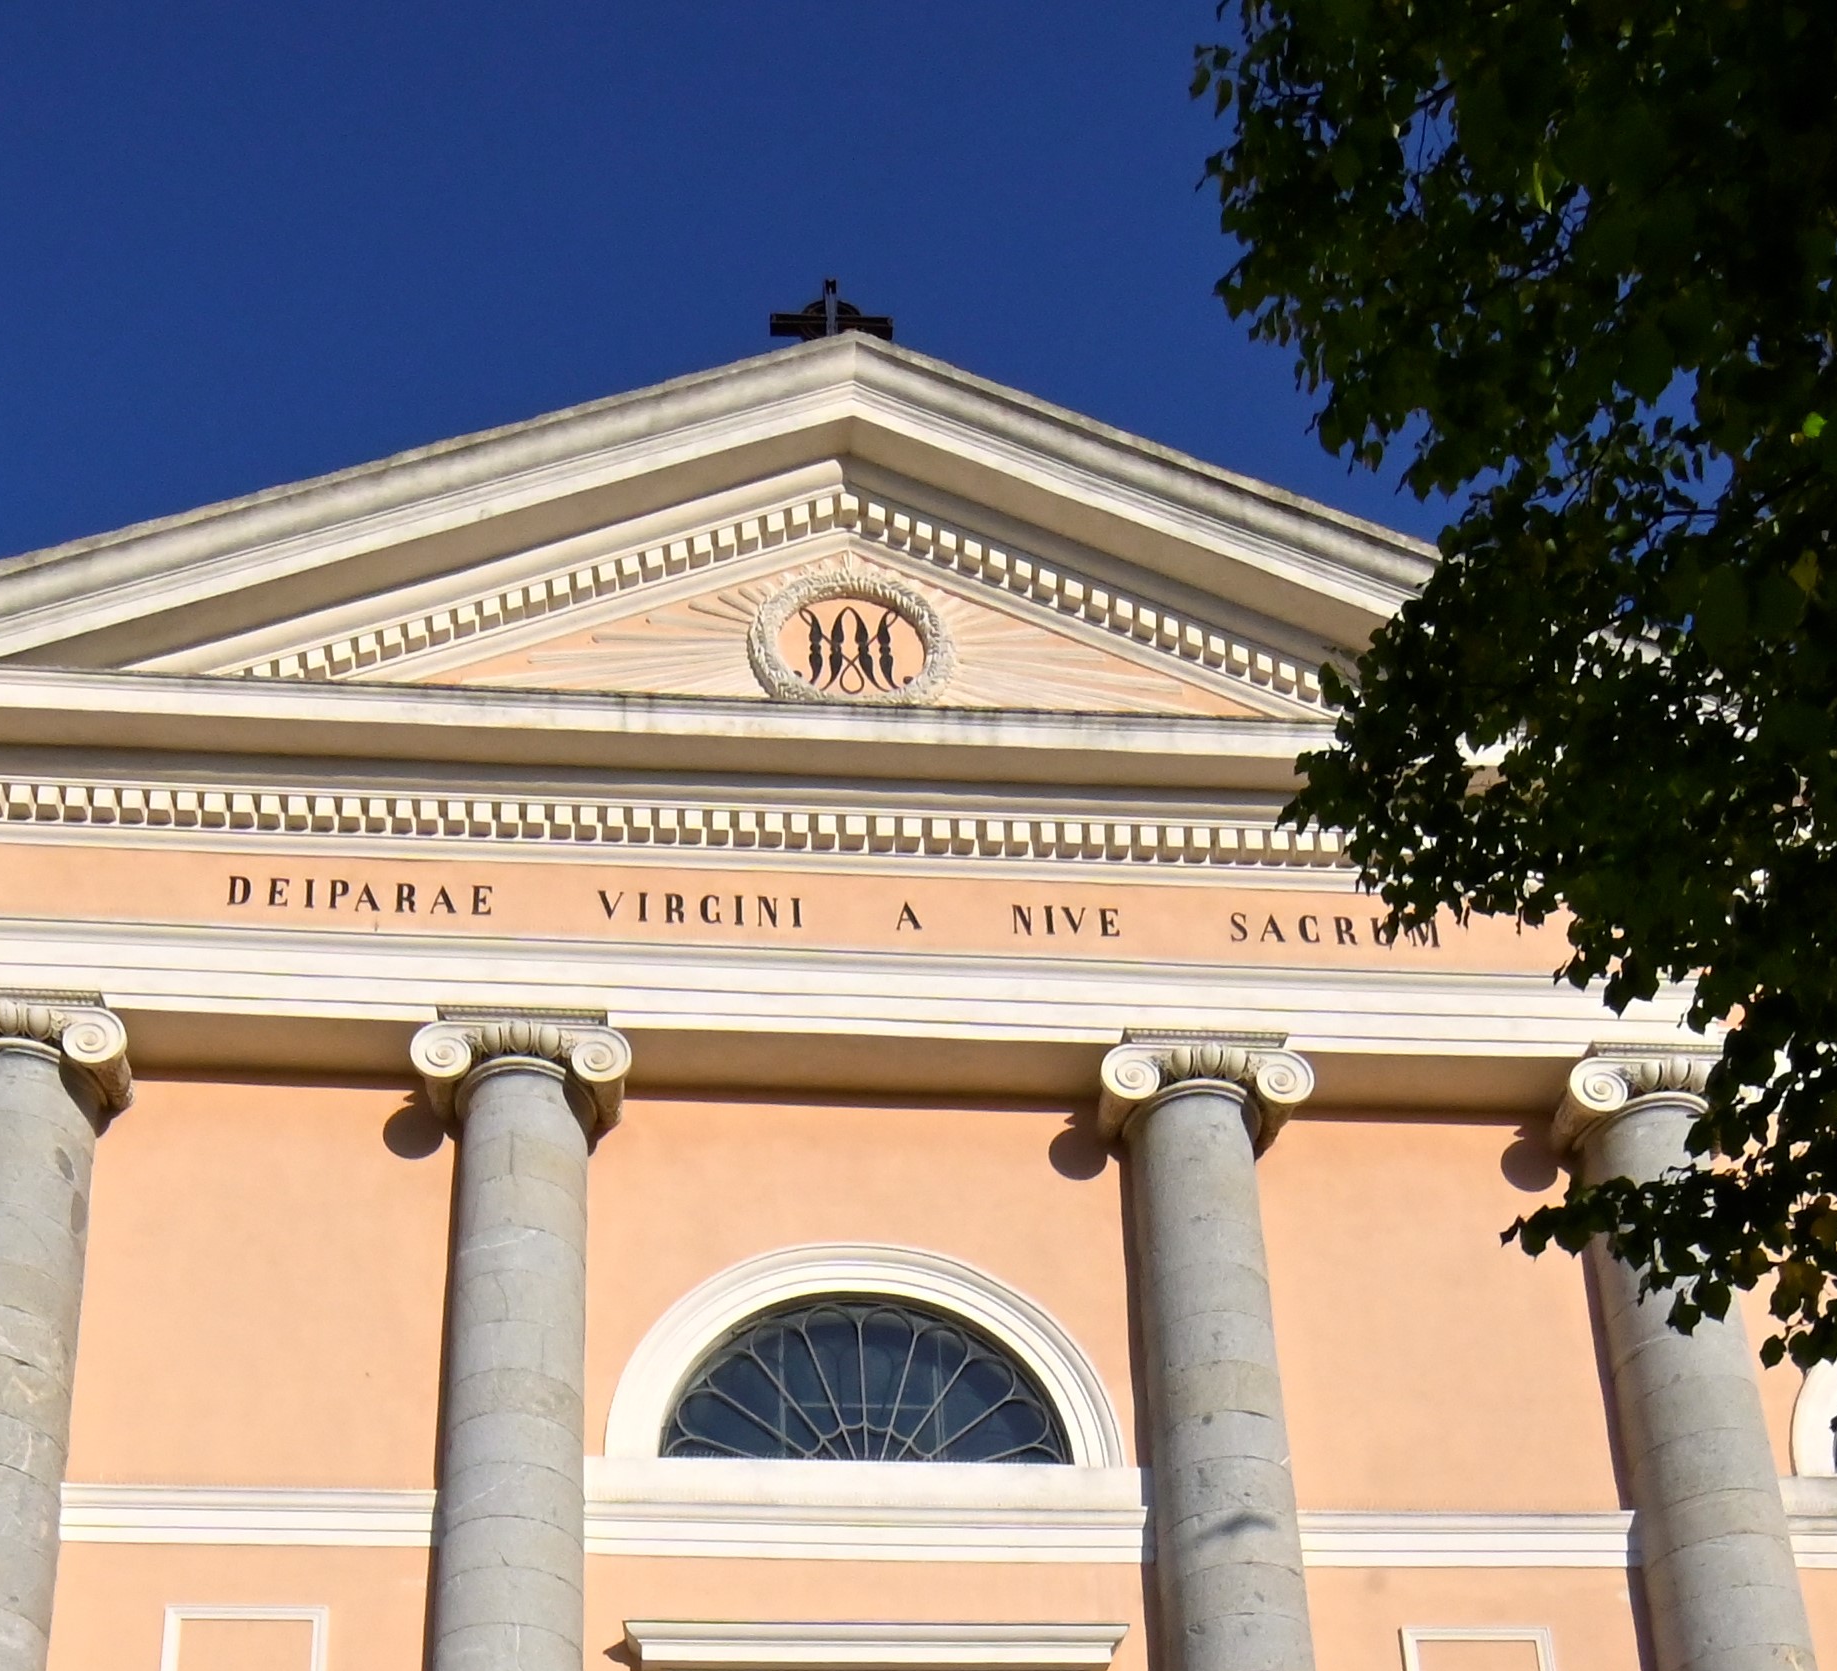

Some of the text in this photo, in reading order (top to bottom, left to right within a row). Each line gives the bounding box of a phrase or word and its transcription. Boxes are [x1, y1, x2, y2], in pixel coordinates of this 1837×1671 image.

[226, 874, 495, 916] DEIPARAE
[597, 889, 803, 929] VIRGINI
[895, 901, 923, 932] A
[1011, 903, 1121, 938] NIVE
